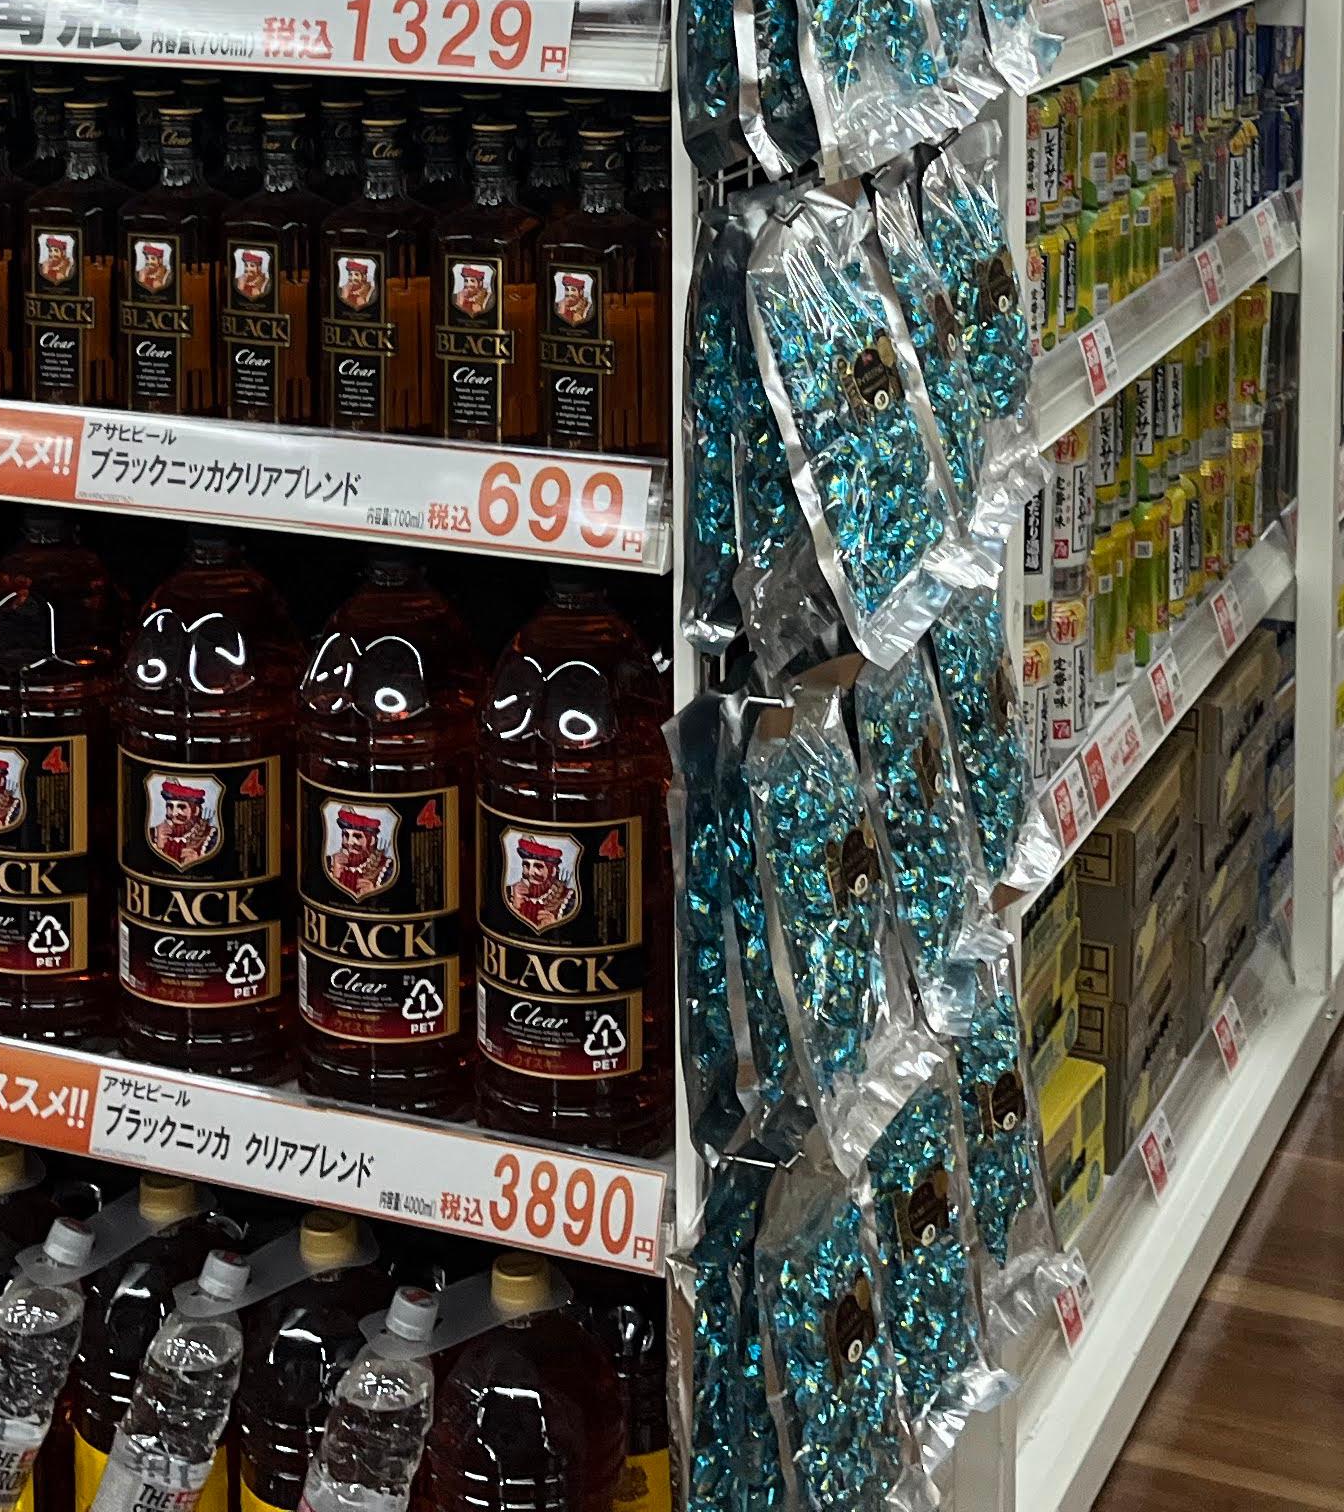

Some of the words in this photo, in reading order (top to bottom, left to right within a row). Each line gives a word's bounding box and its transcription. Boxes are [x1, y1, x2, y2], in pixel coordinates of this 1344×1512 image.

[262, 16, 333, 60] 税込
[26, 299, 92, 324] BLACK
[122, 307, 190, 332] BLACK
[223, 316, 288, 340] BLACK
[323, 325, 393, 351] BLACK
[40, 332, 76, 350] Clear
[136, 341, 172, 359] Clear
[438, 333, 511, 358] BLACK
[235, 349, 271, 368] Clear
[542, 341, 612, 368] BLACK
[338, 359, 376, 378] Clear
[453, 367, 493, 386] Clear
[556, 376, 594, 396] Clear
[89, 422, 177, 446] アサヒビール
[90, 448, 362, 507] ブラックニッカクリアブレンド
[427, 502, 472, 533] 税込
[478, 461, 624, 549] 699
[126, 877, 260, 926] BLACK
[303, 904, 436, 960] BLACK
[154, 936, 212, 962] Clear
[36, 956, 63, 968] PET
[482, 935, 620, 994] BLACK
[234, 985, 259, 999] PET
[330, 967, 388, 995] Clear
[410, 1020, 436, 1034] PET
[510, 1001, 569, 1030] Clear
[592, 1057, 619, 1072] PET
[103, 1074, 191, 1108] アサヒビール
[105, 1103, 231, 1160] ブラックニッカ
[245, 1132, 375, 1188] クリアブレンド
[440, 1190, 484, 1226] 税込
[489, 1153, 635, 1255] 3890
